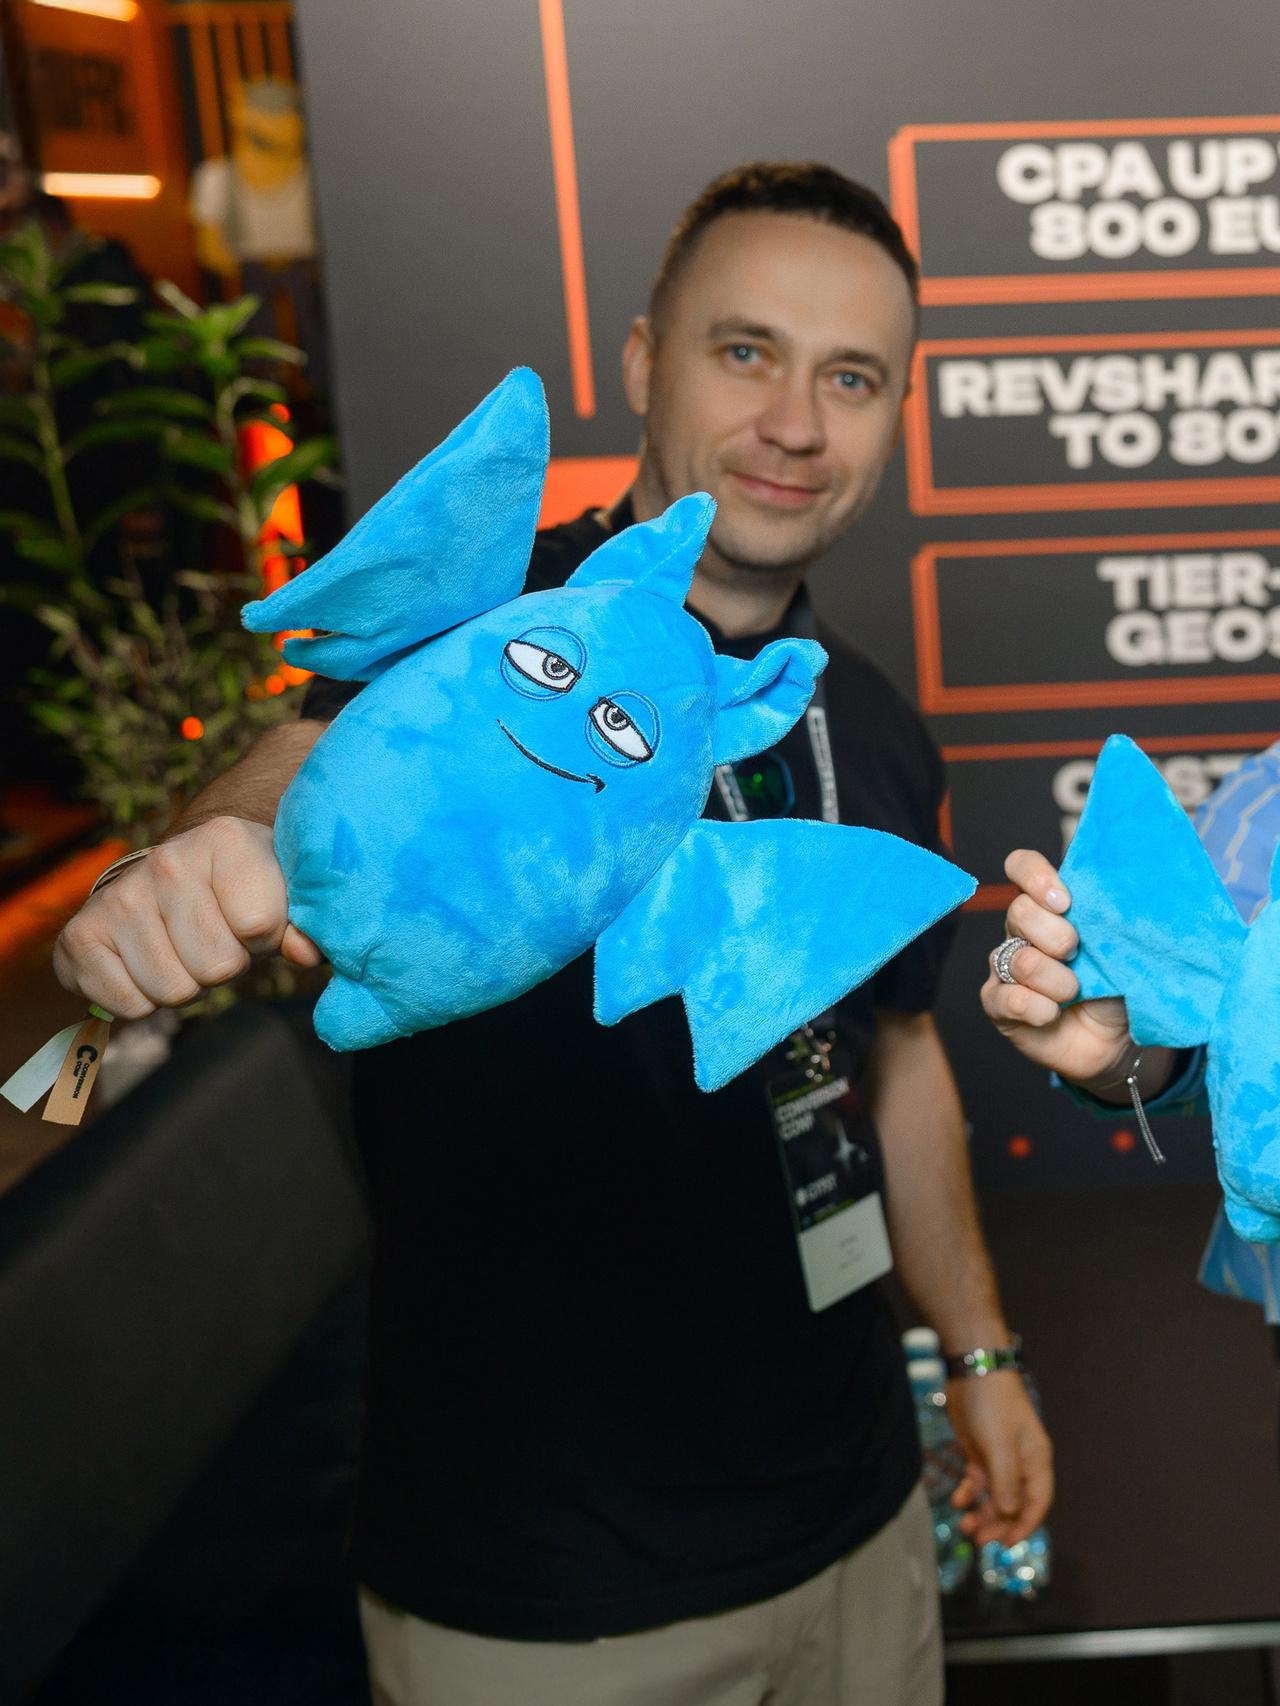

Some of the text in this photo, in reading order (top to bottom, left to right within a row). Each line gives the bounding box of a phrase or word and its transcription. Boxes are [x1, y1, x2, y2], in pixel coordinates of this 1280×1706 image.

[997, 142, 1163, 203] CPA
[1168, 138, 1276, 199] UP
[1029, 202, 1201, 261] 800
[1049, 412, 1161, 469] TO
